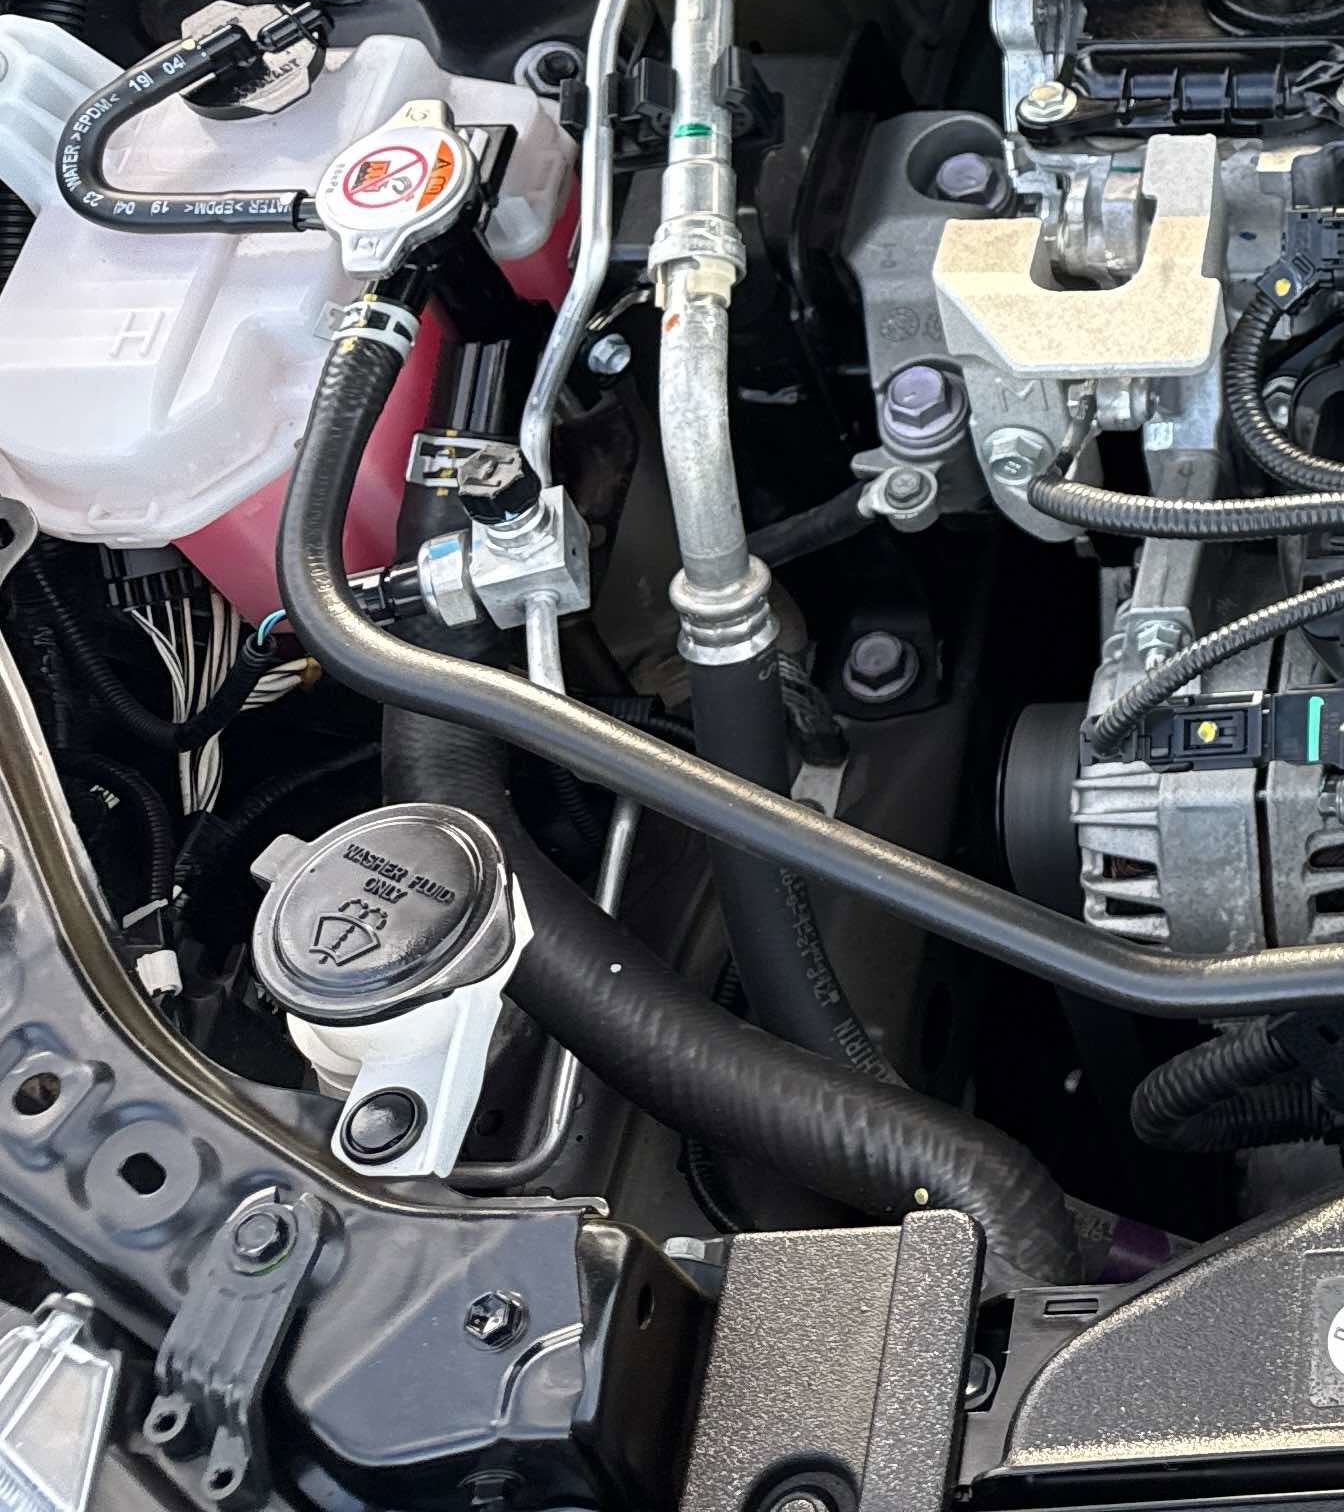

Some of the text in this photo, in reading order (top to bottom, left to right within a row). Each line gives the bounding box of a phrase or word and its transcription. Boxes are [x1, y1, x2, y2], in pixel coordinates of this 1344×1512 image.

[62, 144, 84, 192] WATER
[82, 191, 104, 208] 23
[343, 844, 456, 904] WASHER FLUID
[363, 877, 408, 905] ONLY
